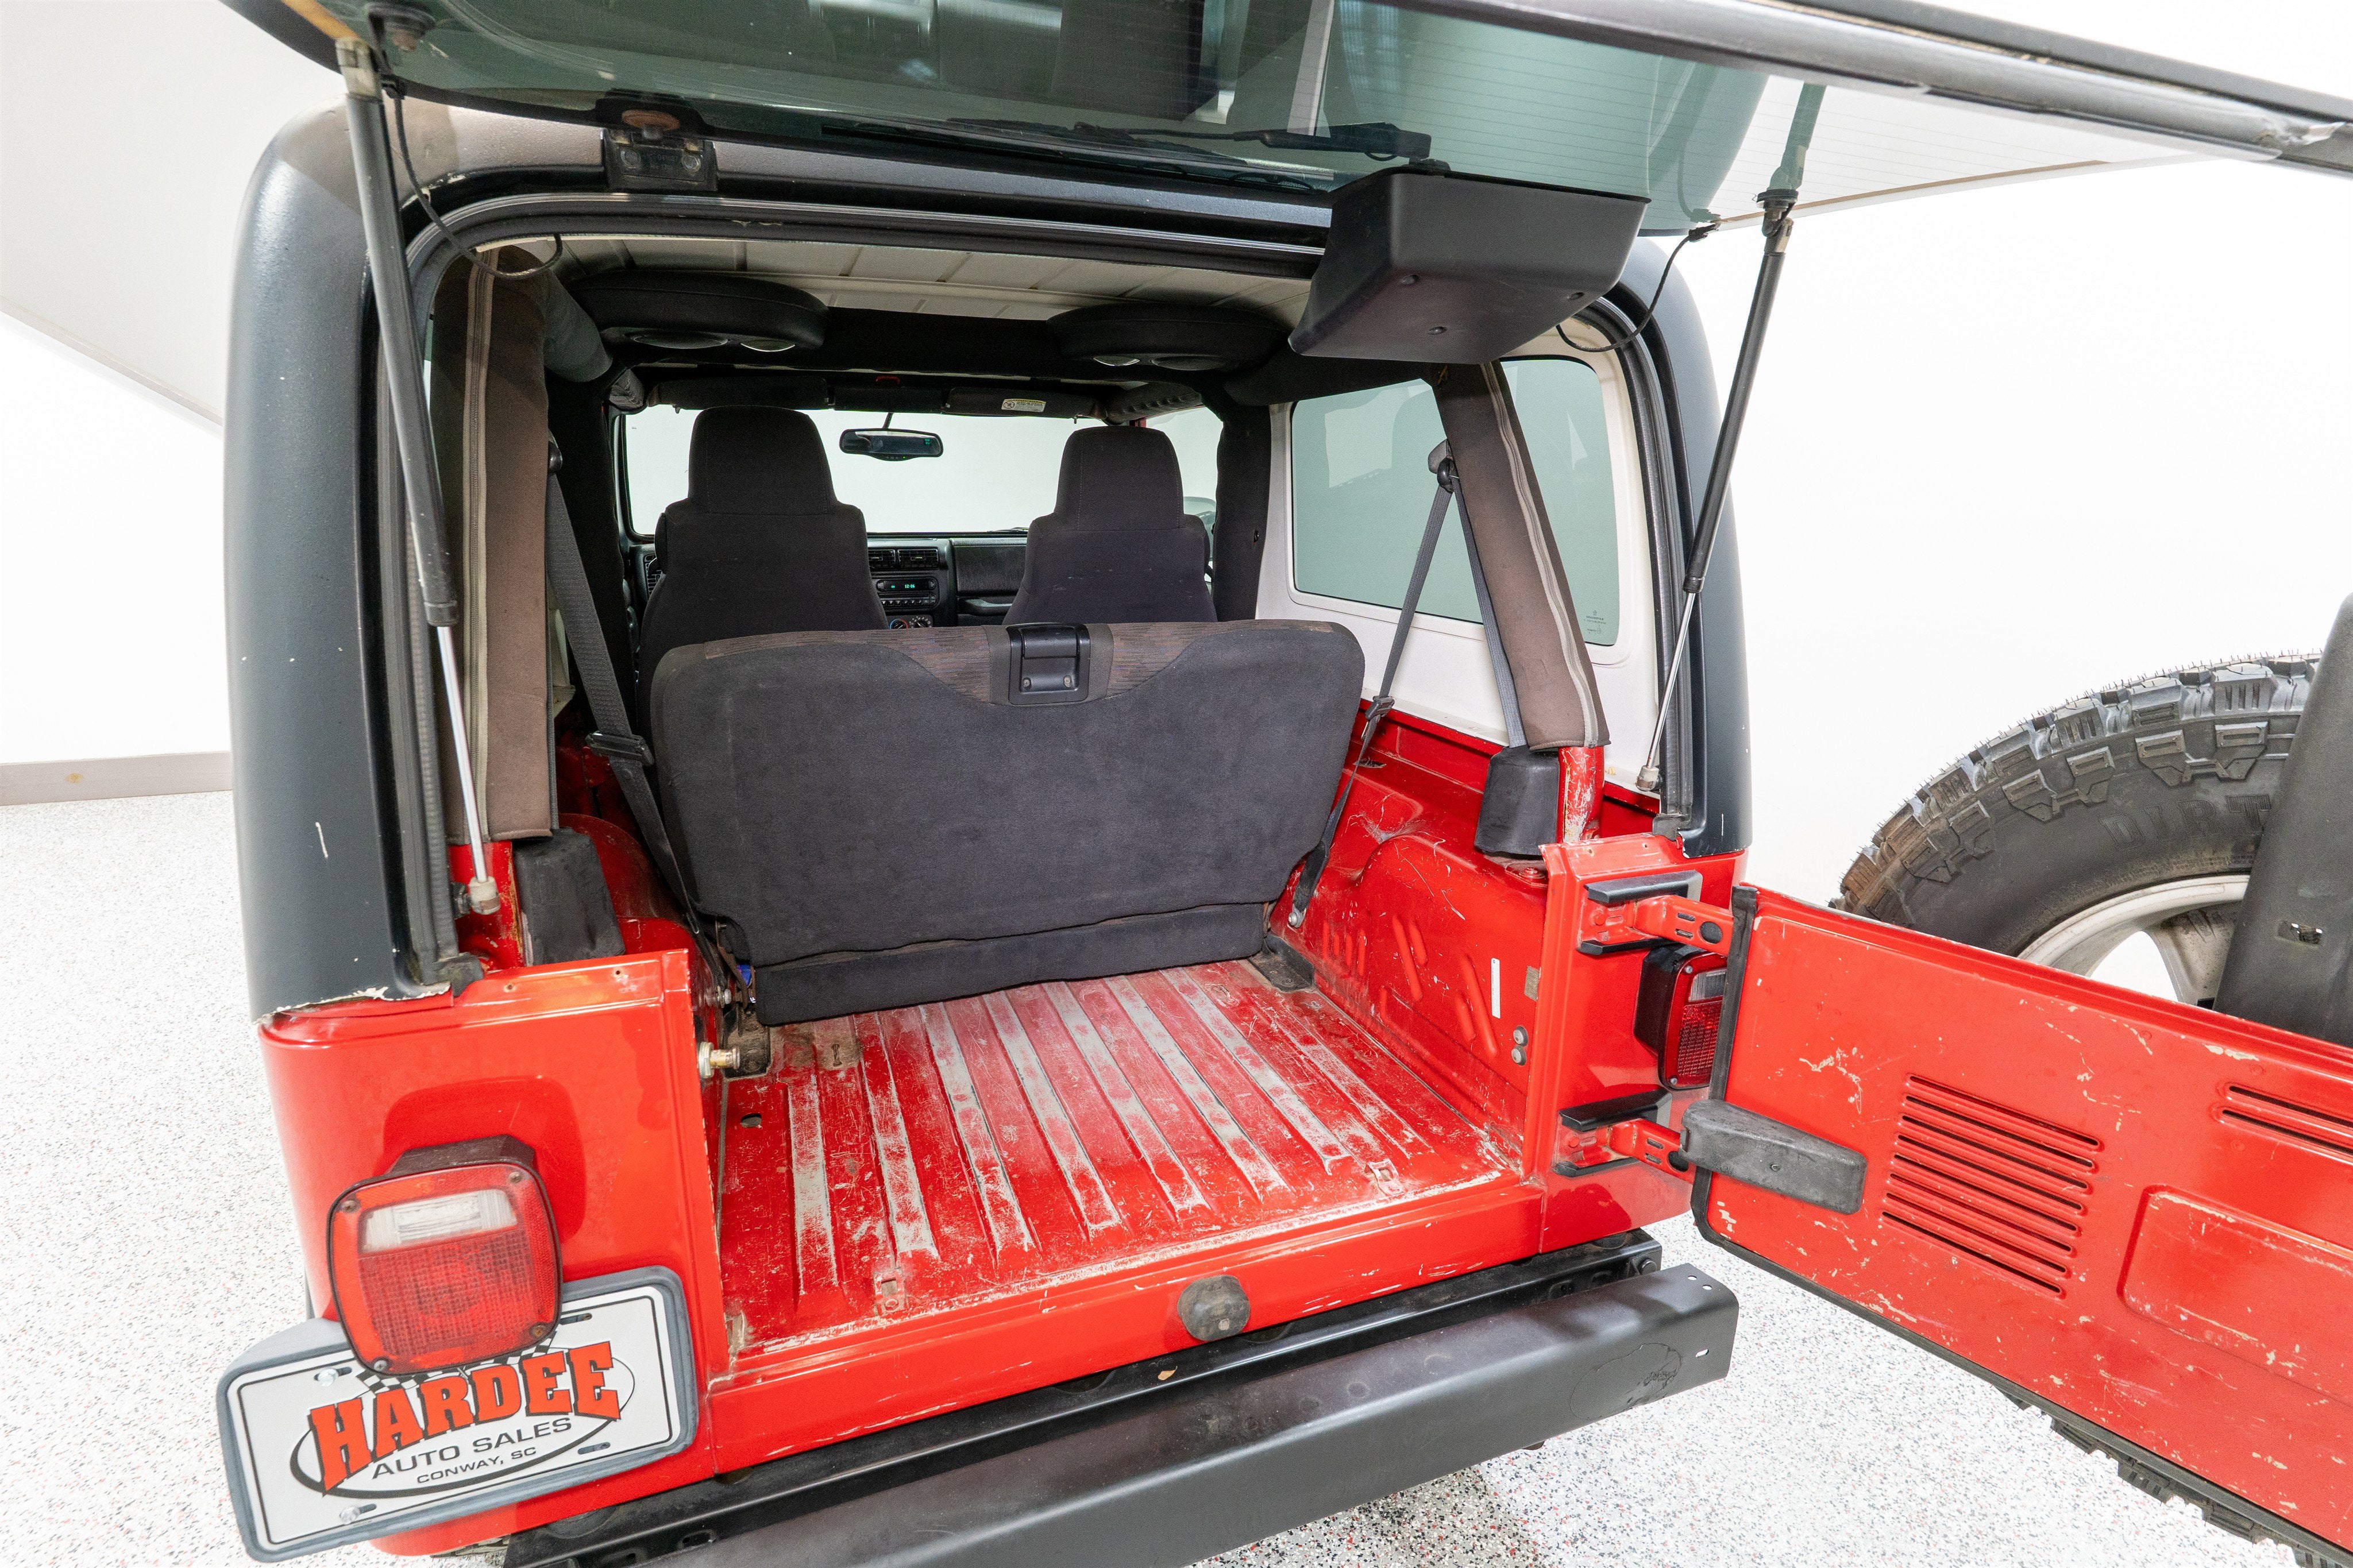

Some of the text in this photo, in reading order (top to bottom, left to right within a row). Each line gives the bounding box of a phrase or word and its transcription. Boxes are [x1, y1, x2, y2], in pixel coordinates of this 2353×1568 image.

[307, 1341, 621, 1497] HARDEE
[372, 1417, 572, 1480] AUTO SALES
[416, 1446, 537, 1484] CONWAY, SC
